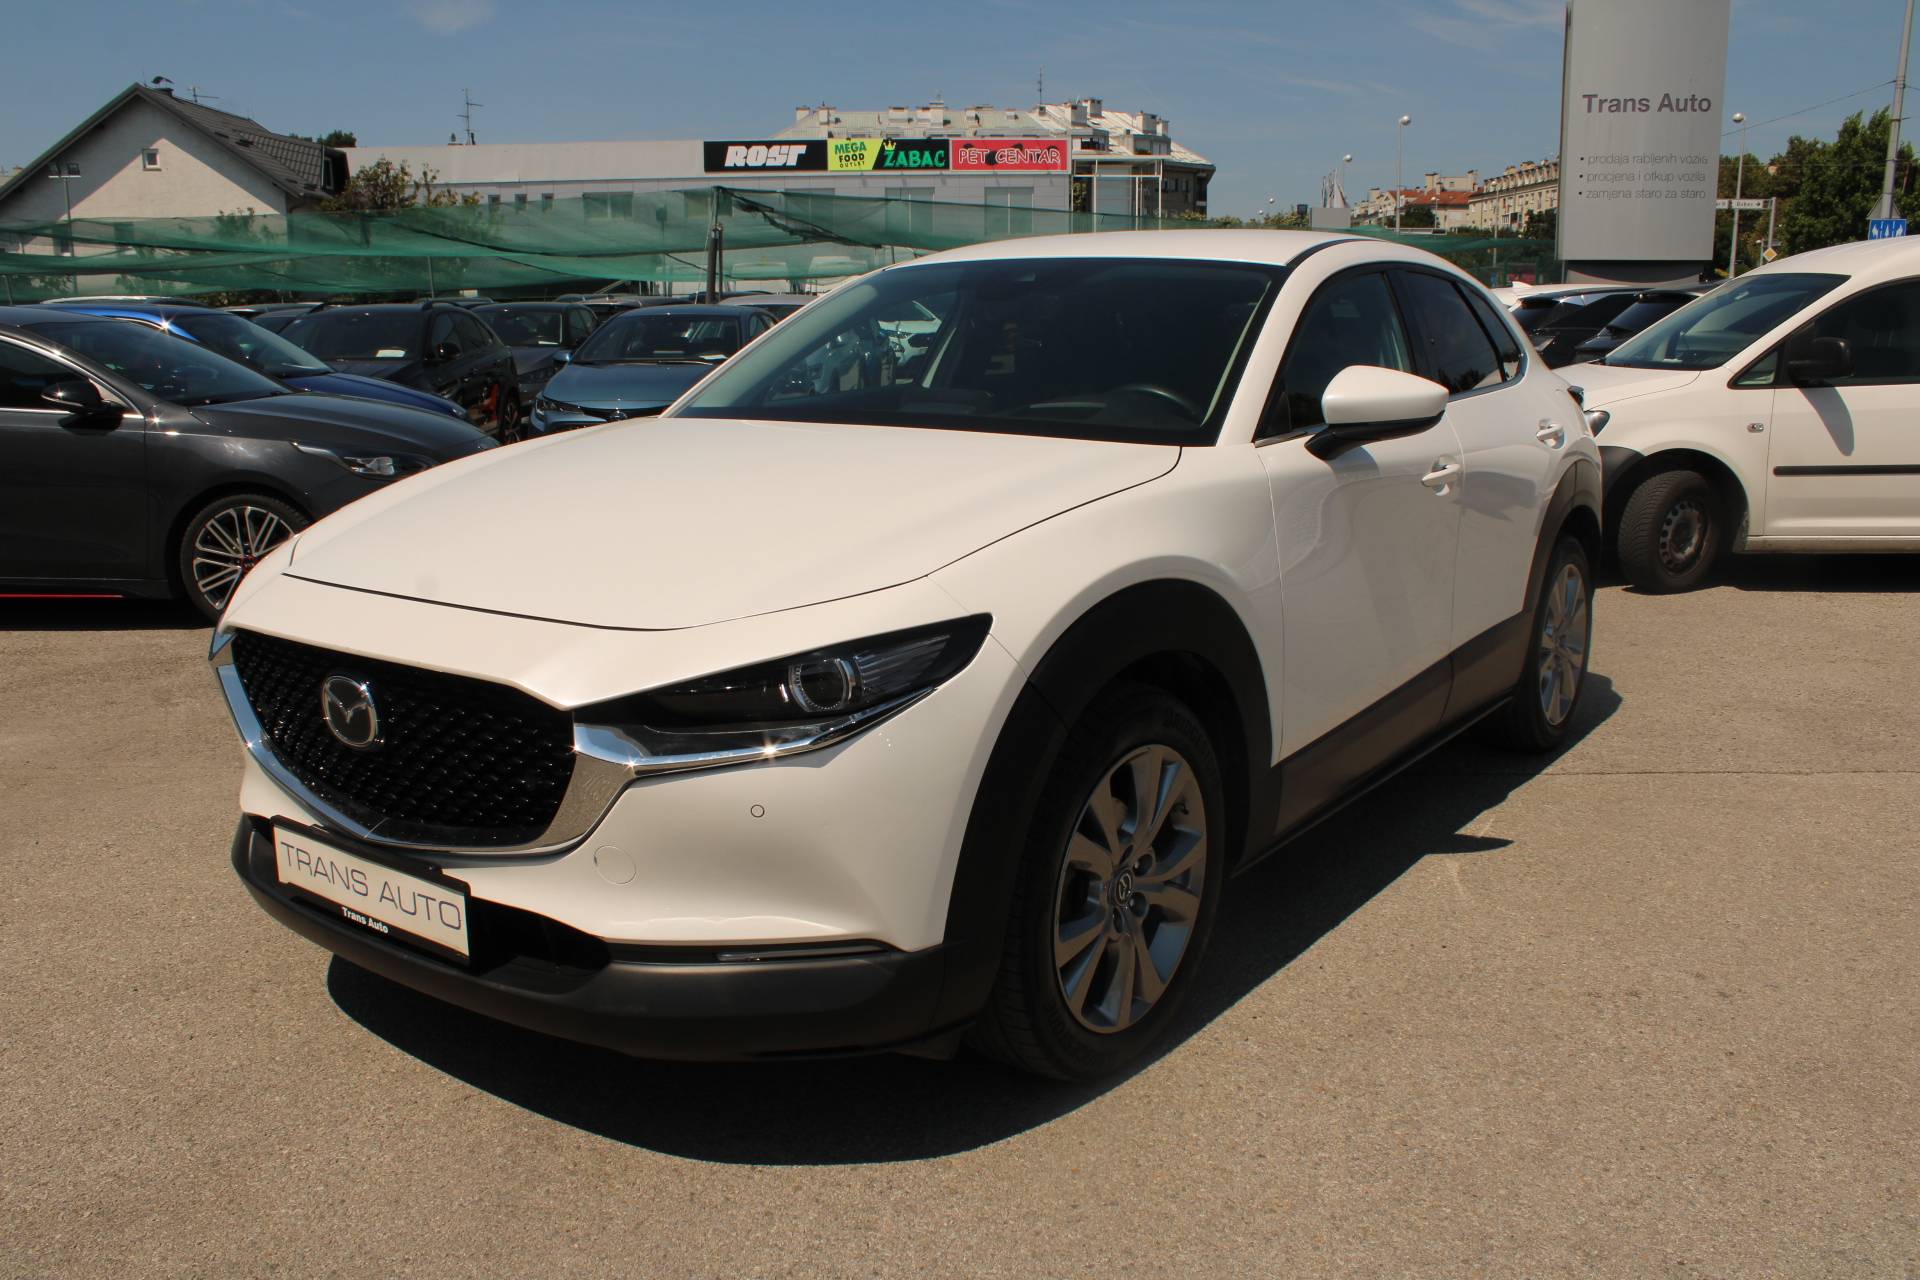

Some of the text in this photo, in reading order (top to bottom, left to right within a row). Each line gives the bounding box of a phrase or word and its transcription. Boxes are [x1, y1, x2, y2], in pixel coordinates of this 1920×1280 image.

[1582, 93, 1712, 114] Trans Auto
[834, 141, 868, 155] MEGA
[724, 144, 807, 168] ROST
[838, 153, 865, 163] FOOD
[959, 148, 1062, 164] PET CENTAR
[1587, 153, 1630, 165] prodaja
[1643, 171, 1674, 183] otkup
[1678, 171, 1706, 182] vozila
[1635, 188, 1662, 199] staro
[1664, 189, 1677, 199] za
[1680, 188, 1706, 199] staro
[280, 841, 462, 930] TRANS AUTO
[341, 906, 389, 934] Trans Auto
